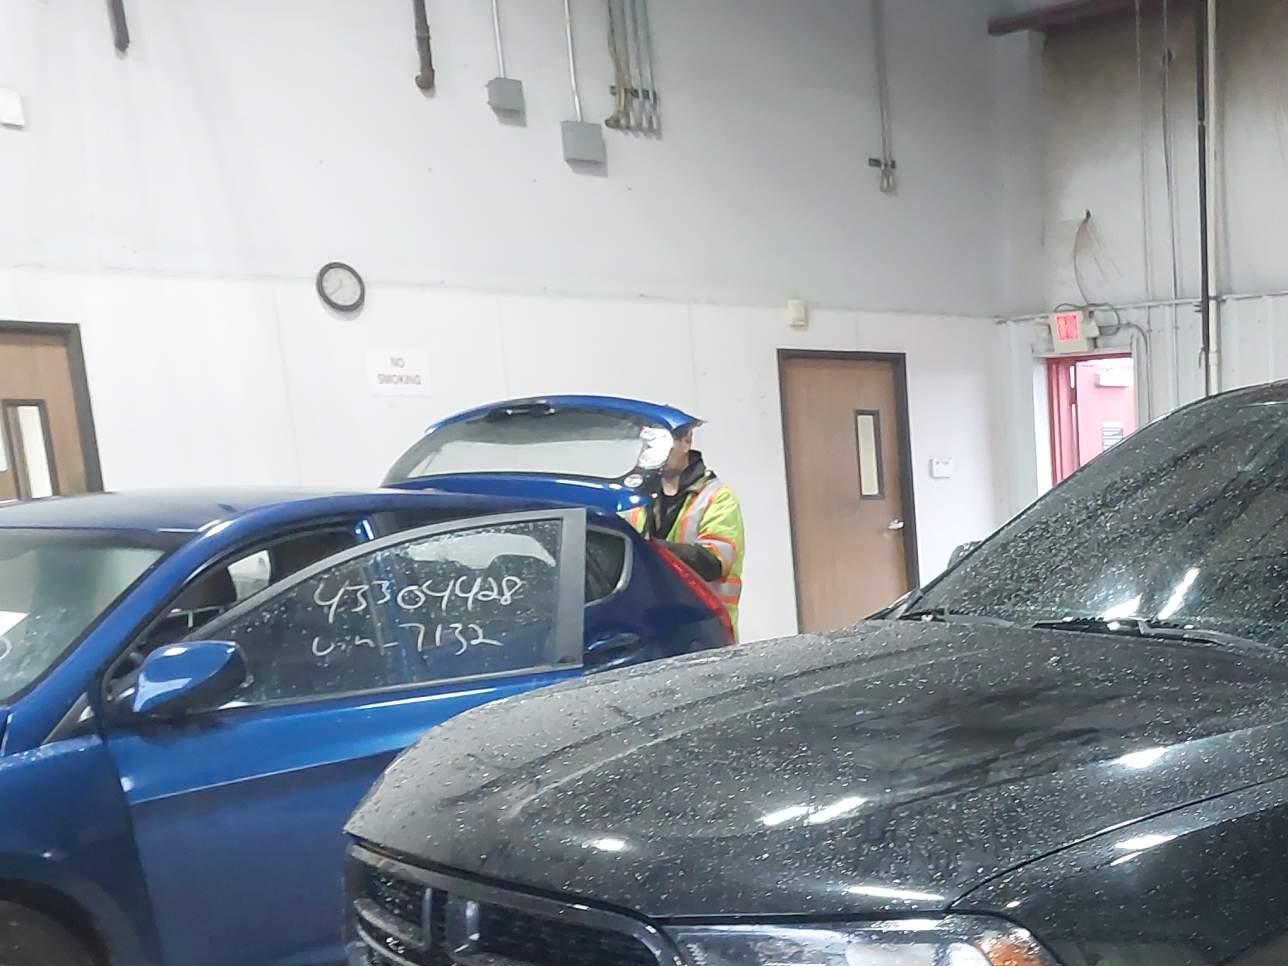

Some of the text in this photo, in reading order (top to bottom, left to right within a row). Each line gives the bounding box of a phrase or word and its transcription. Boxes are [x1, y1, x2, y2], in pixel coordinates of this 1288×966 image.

[389, 356, 406, 369] NO
[377, 373, 422, 386] SMOKING
[313, 575, 523, 624] 43304428
